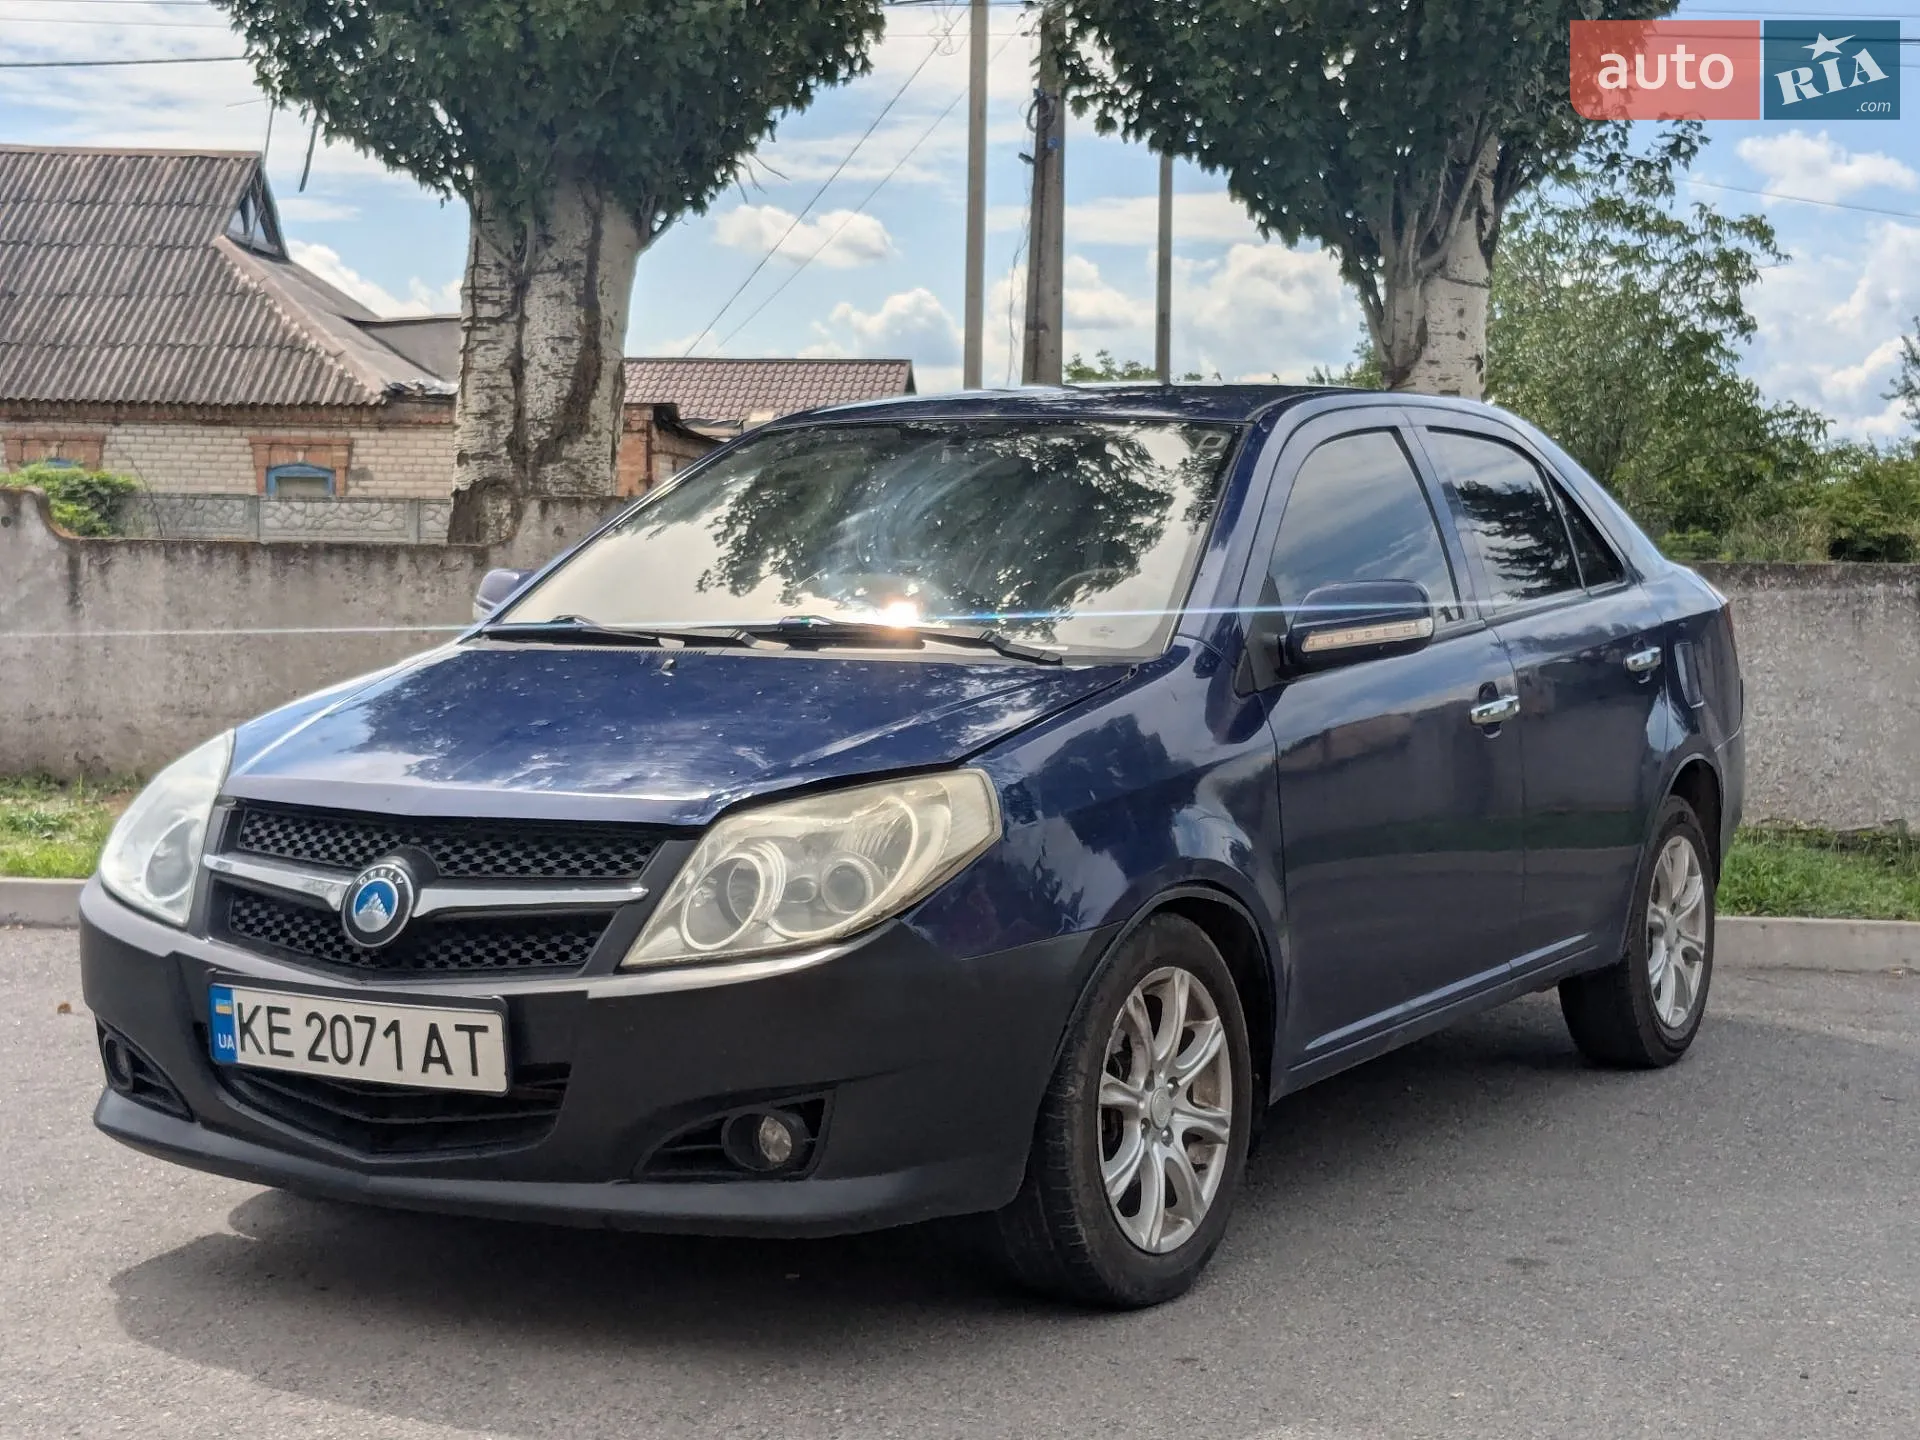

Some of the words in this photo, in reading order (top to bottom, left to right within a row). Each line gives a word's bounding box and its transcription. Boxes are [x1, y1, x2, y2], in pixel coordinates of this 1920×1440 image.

[217, 1033, 236, 1051] UA
[236, 1002, 295, 1057] KE
[305, 1011, 404, 1072] 2071
[421, 1022, 489, 1077] AT
